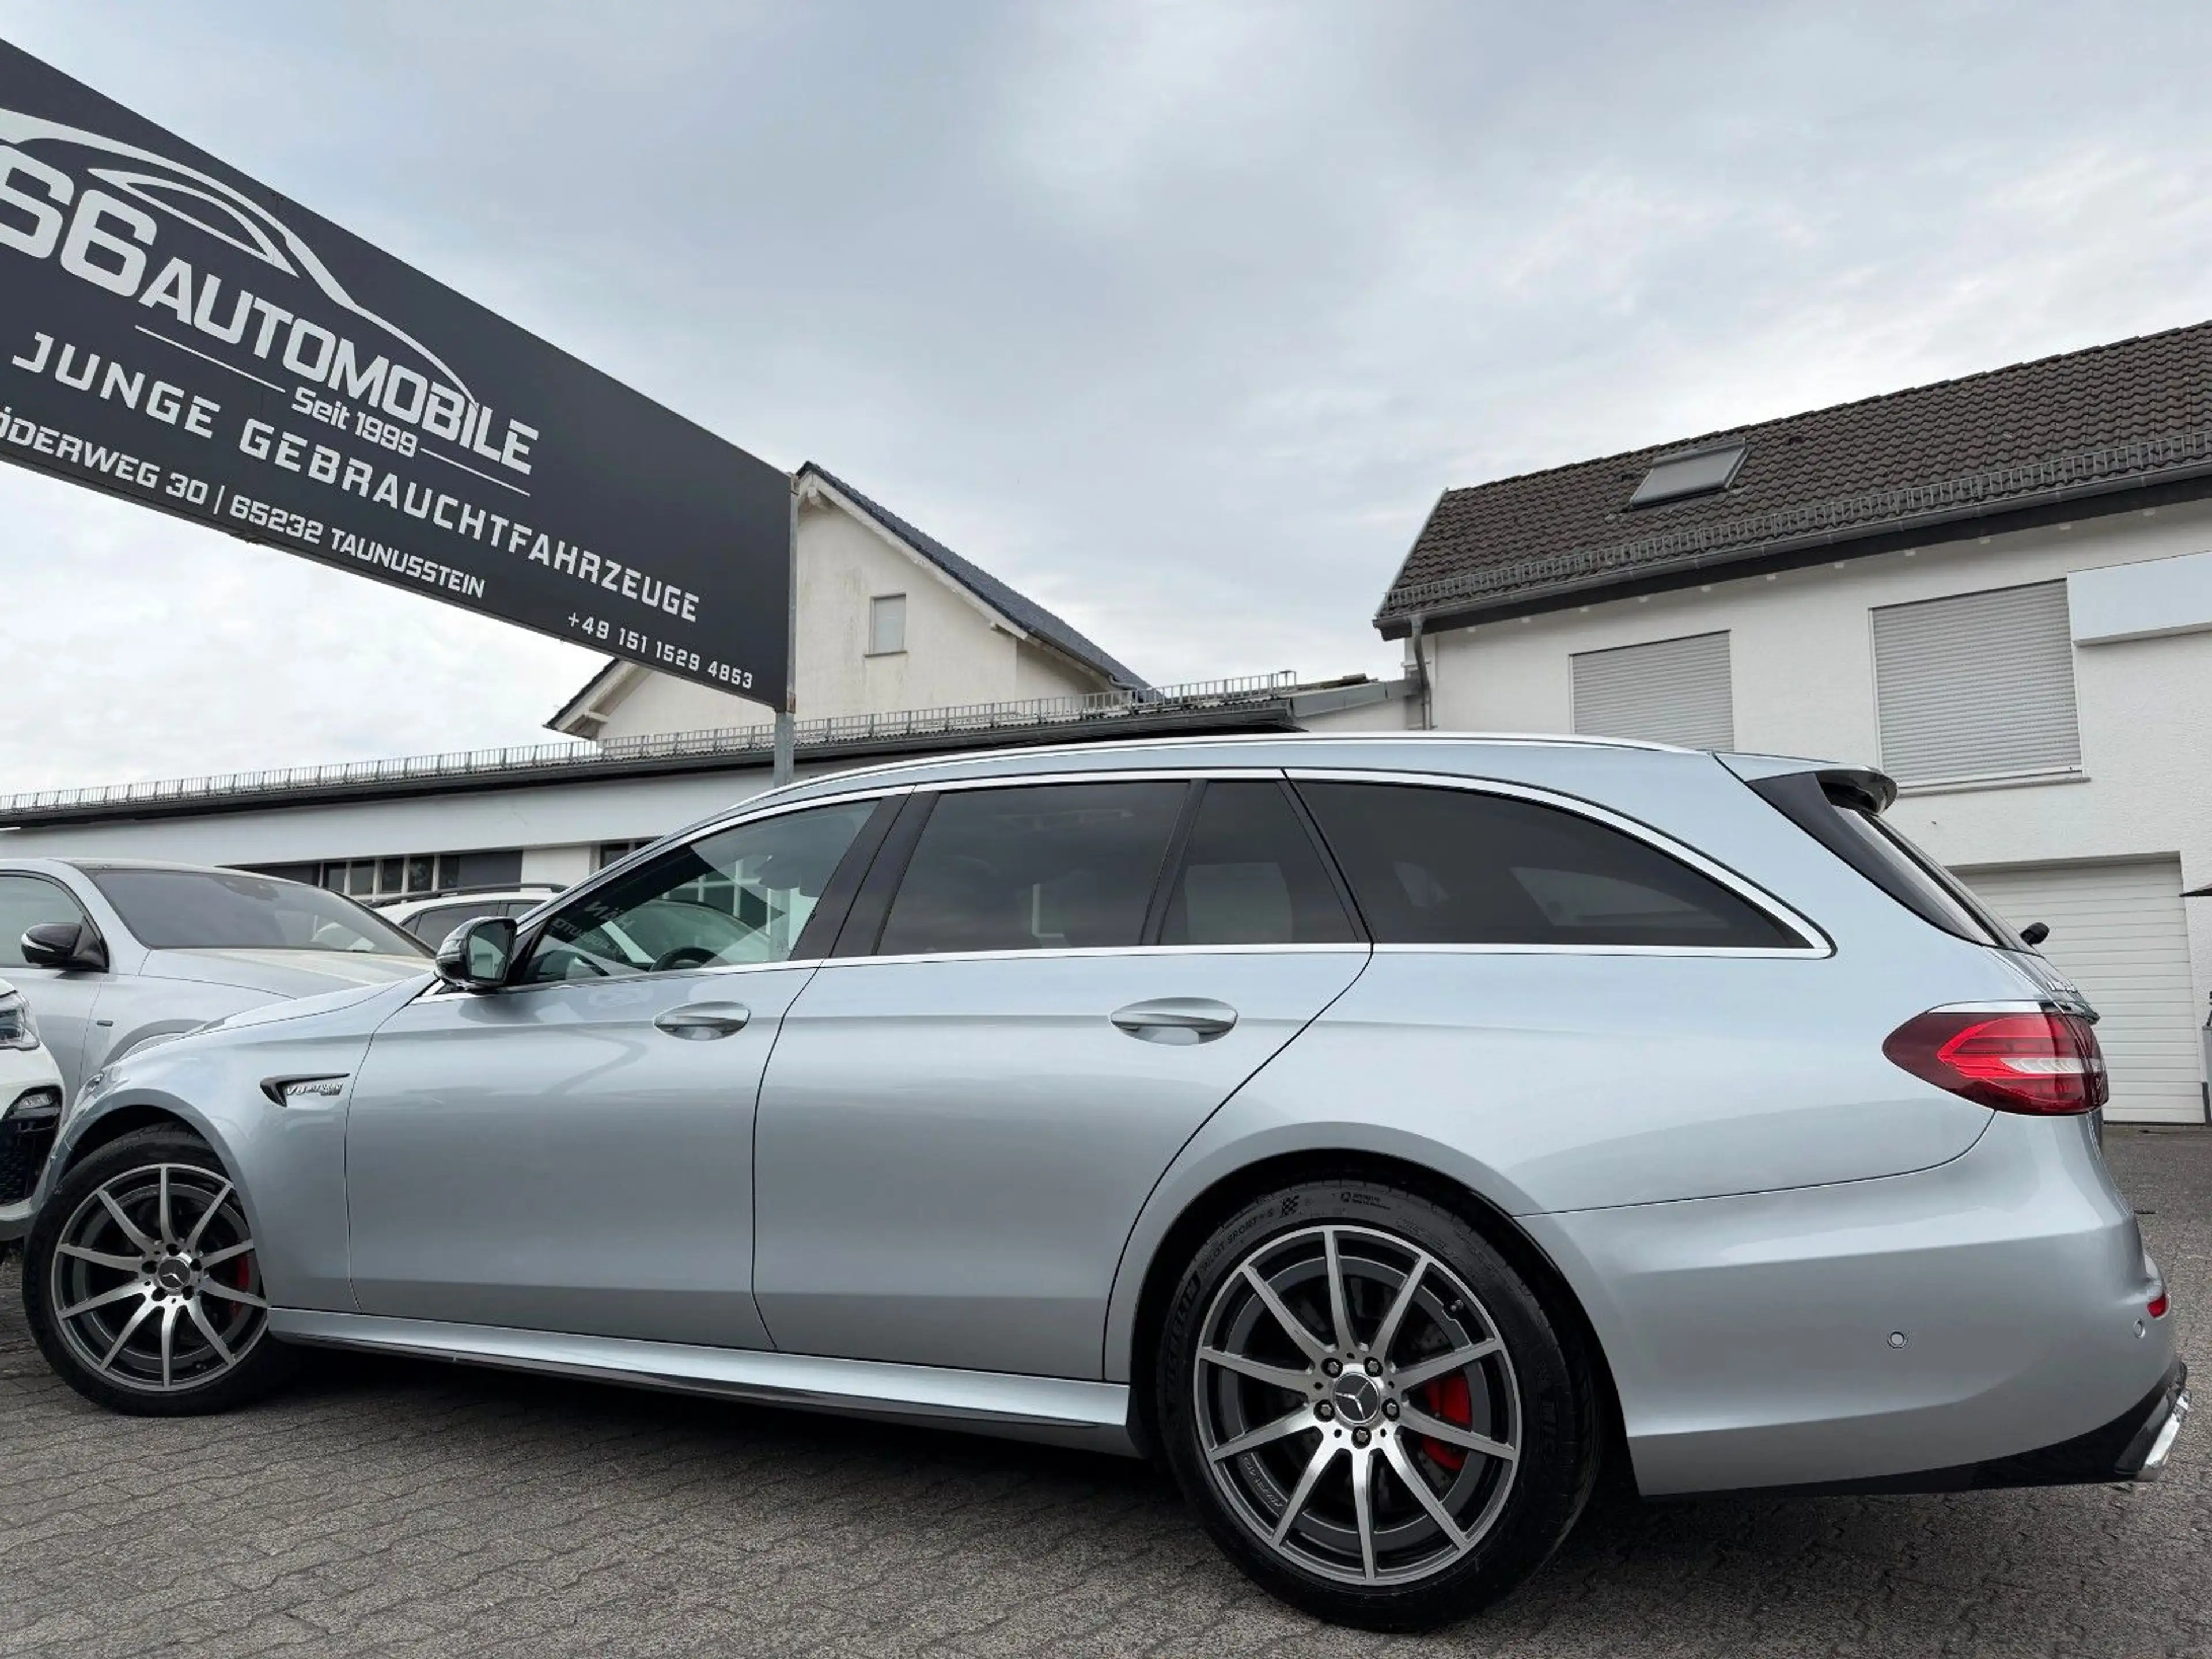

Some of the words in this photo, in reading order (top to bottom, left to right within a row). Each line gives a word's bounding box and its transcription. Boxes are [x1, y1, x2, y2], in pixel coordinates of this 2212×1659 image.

[291, 386, 350, 430] Seit
[355, 411, 418, 458] 1999
[12, 332, 221, 439] JUNGE
[240, 419, 699, 622] GEBRAUCHTFAHRZEUGE
[166, 472, 209, 505] 30
[229, 494, 324, 544] 65232
[332, 528, 485, 599] TAUNUSSTEIN
[567, 612, 609, 640] +49
[619, 627, 647, 653] 151
[656, 641, 701, 672] 1529
[707, 661, 753, 690] 4853
